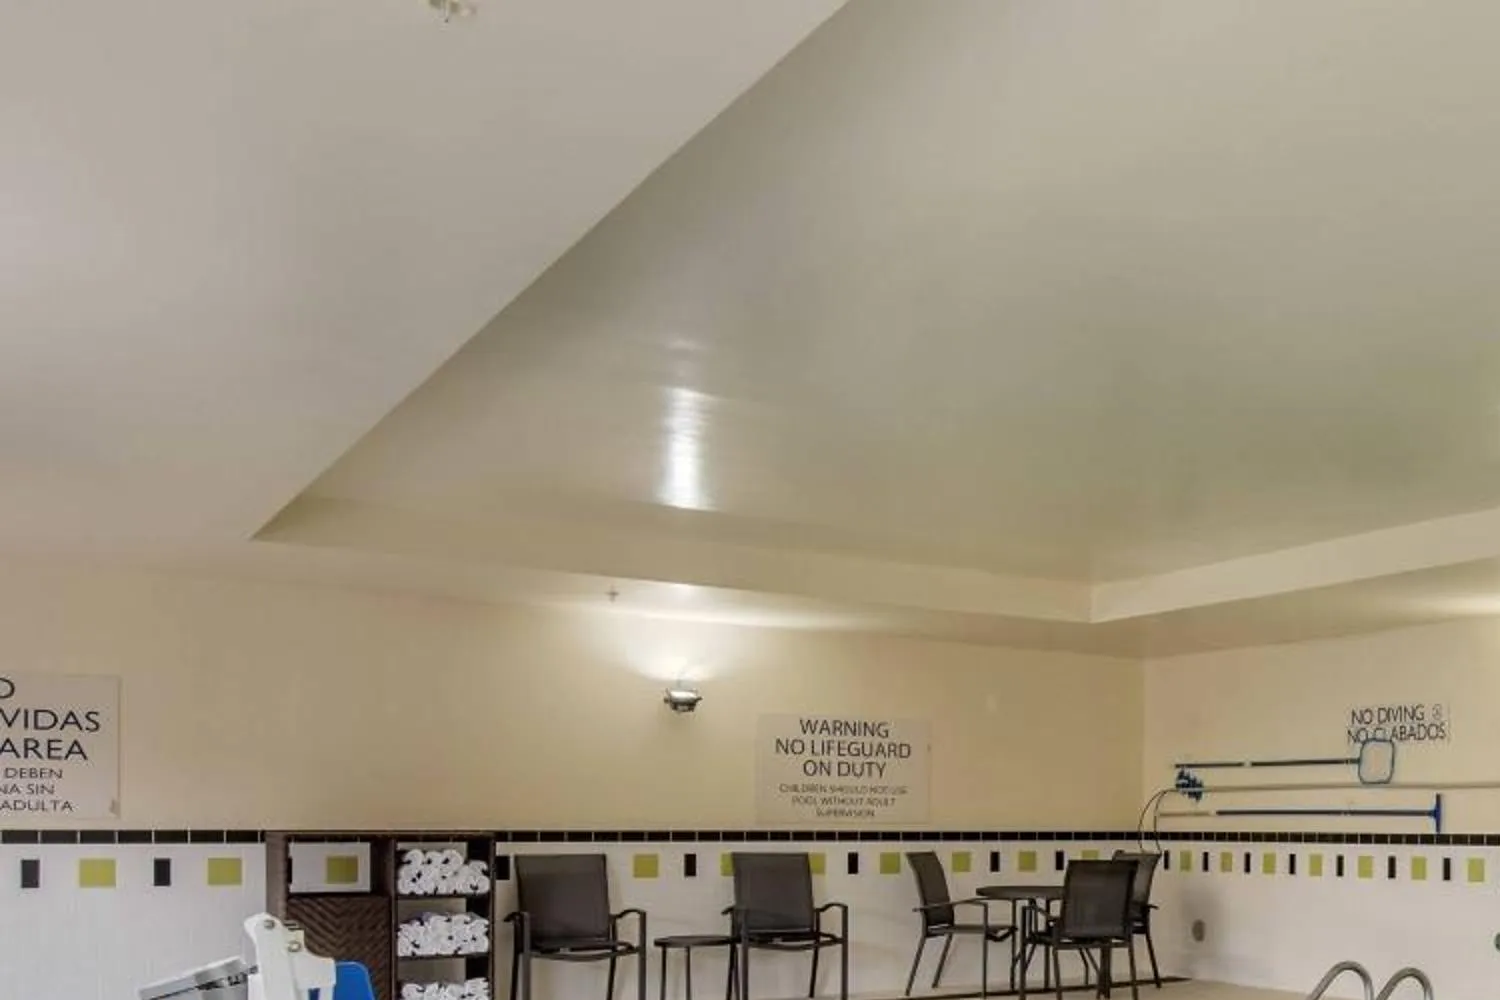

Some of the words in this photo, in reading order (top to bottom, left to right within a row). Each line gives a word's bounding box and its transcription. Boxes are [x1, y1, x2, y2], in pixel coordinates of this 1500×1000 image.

[0, 707, 101, 733] VIDAS
[1351, 708, 1373, 725] NO
[1377, 703, 1425, 724] DIVING
[799, 718, 889, 739] WARNING
[1347, 727, 1369, 744] NO
[0, 737, 88, 761] AREA
[775, 738, 805, 756] NO
[811, 739, 912, 759] LIFEGUARD
[5, 767, 63, 779] DEBEN
[803, 759, 831, 777] ON
[837, 760, 887, 778] DUTY
[26, 783, 55, 795] SIN
[0, 799, 74, 813] ADULTA
